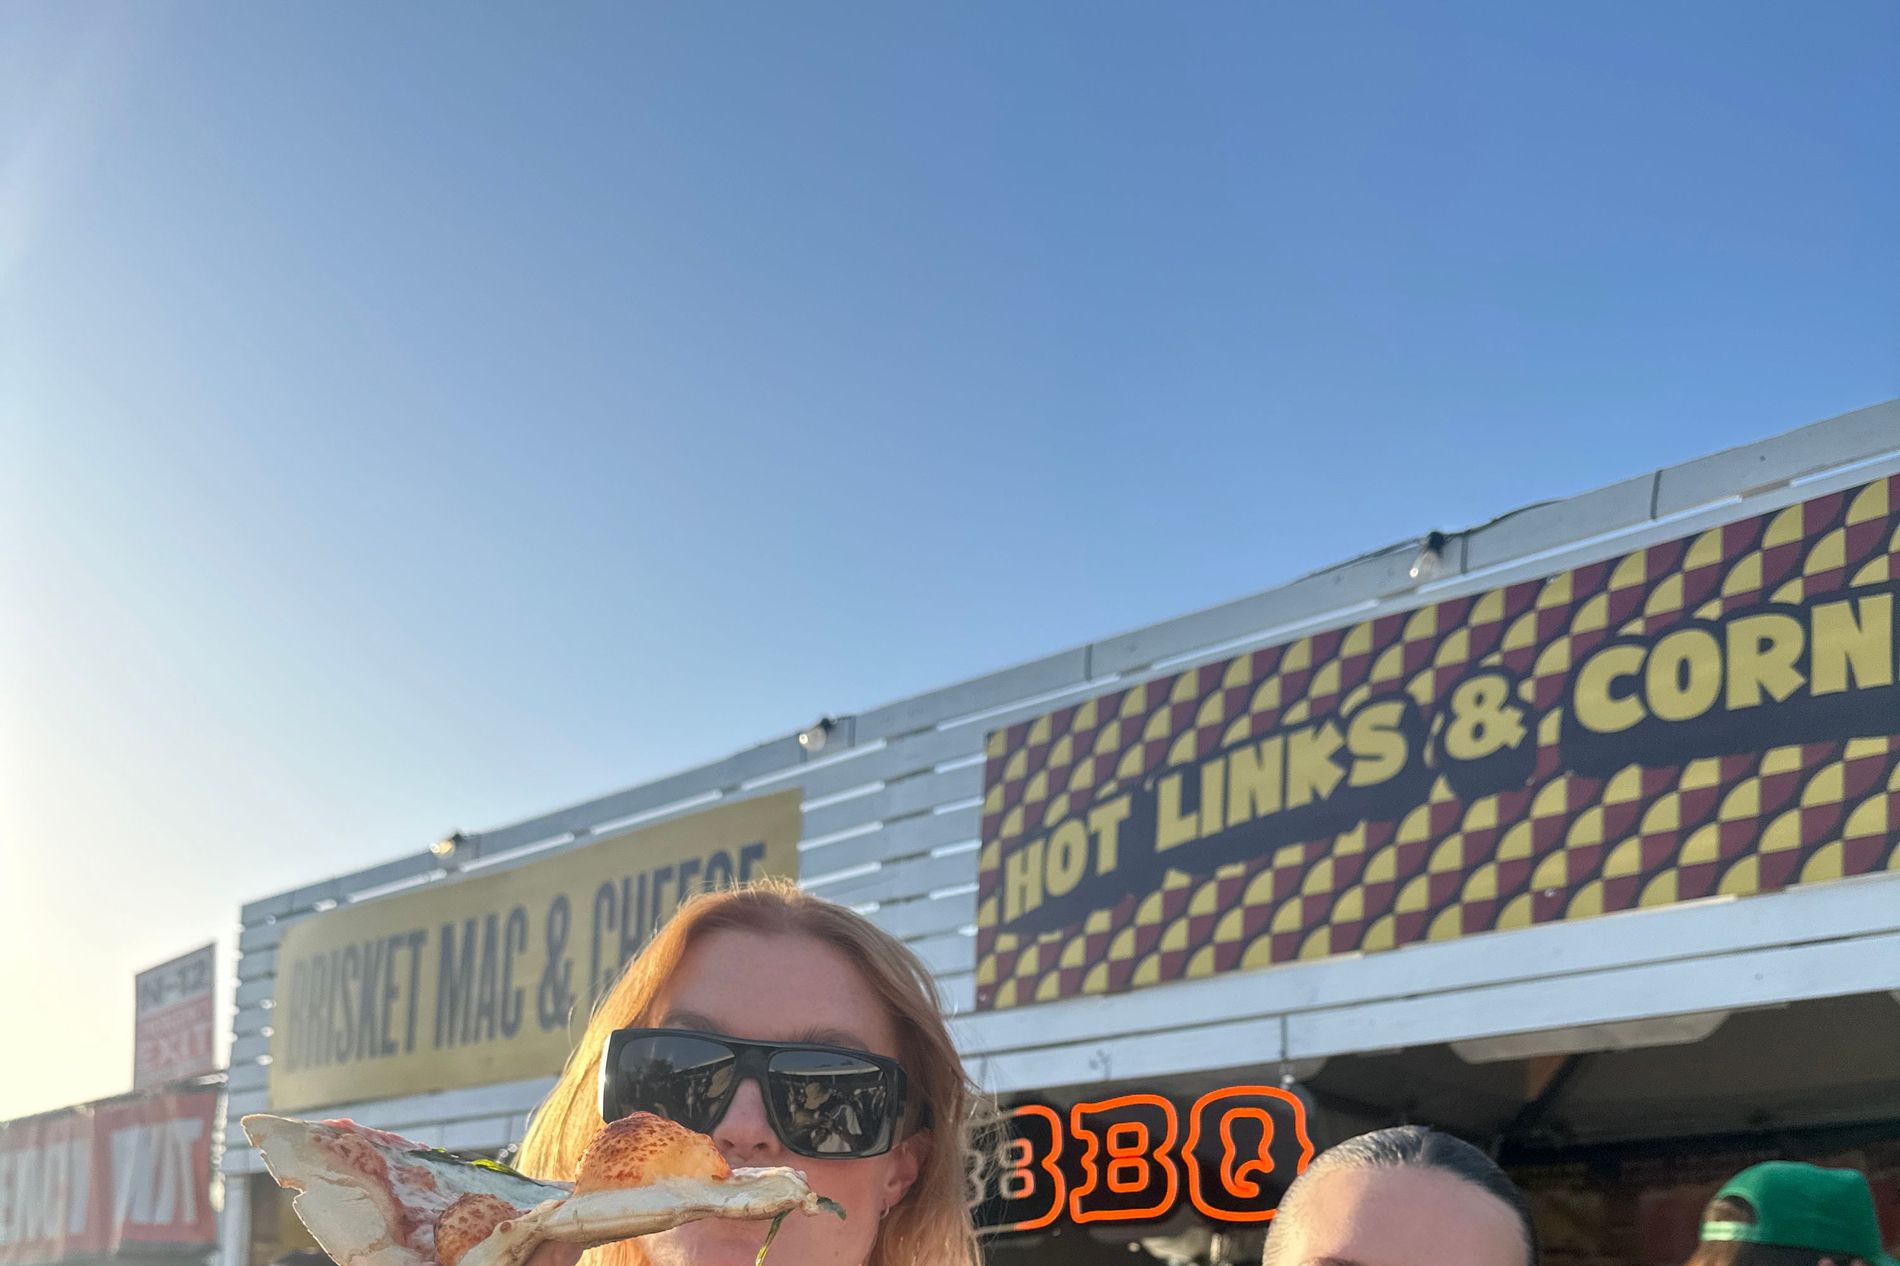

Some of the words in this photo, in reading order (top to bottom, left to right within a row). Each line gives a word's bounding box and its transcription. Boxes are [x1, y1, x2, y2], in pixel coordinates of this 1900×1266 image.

[1003, 798, 1131, 926] HOT
[1153, 700, 1409, 853] LINKS
[1444, 674, 1527, 761] &
[1572, 592, 1895, 735] CORN
[286, 930, 427, 1074] BRISKET
[432, 905, 529, 1050] MAC
[537, 892, 576, 1033] &
[965, 1085, 1315, 1233] BBQ
